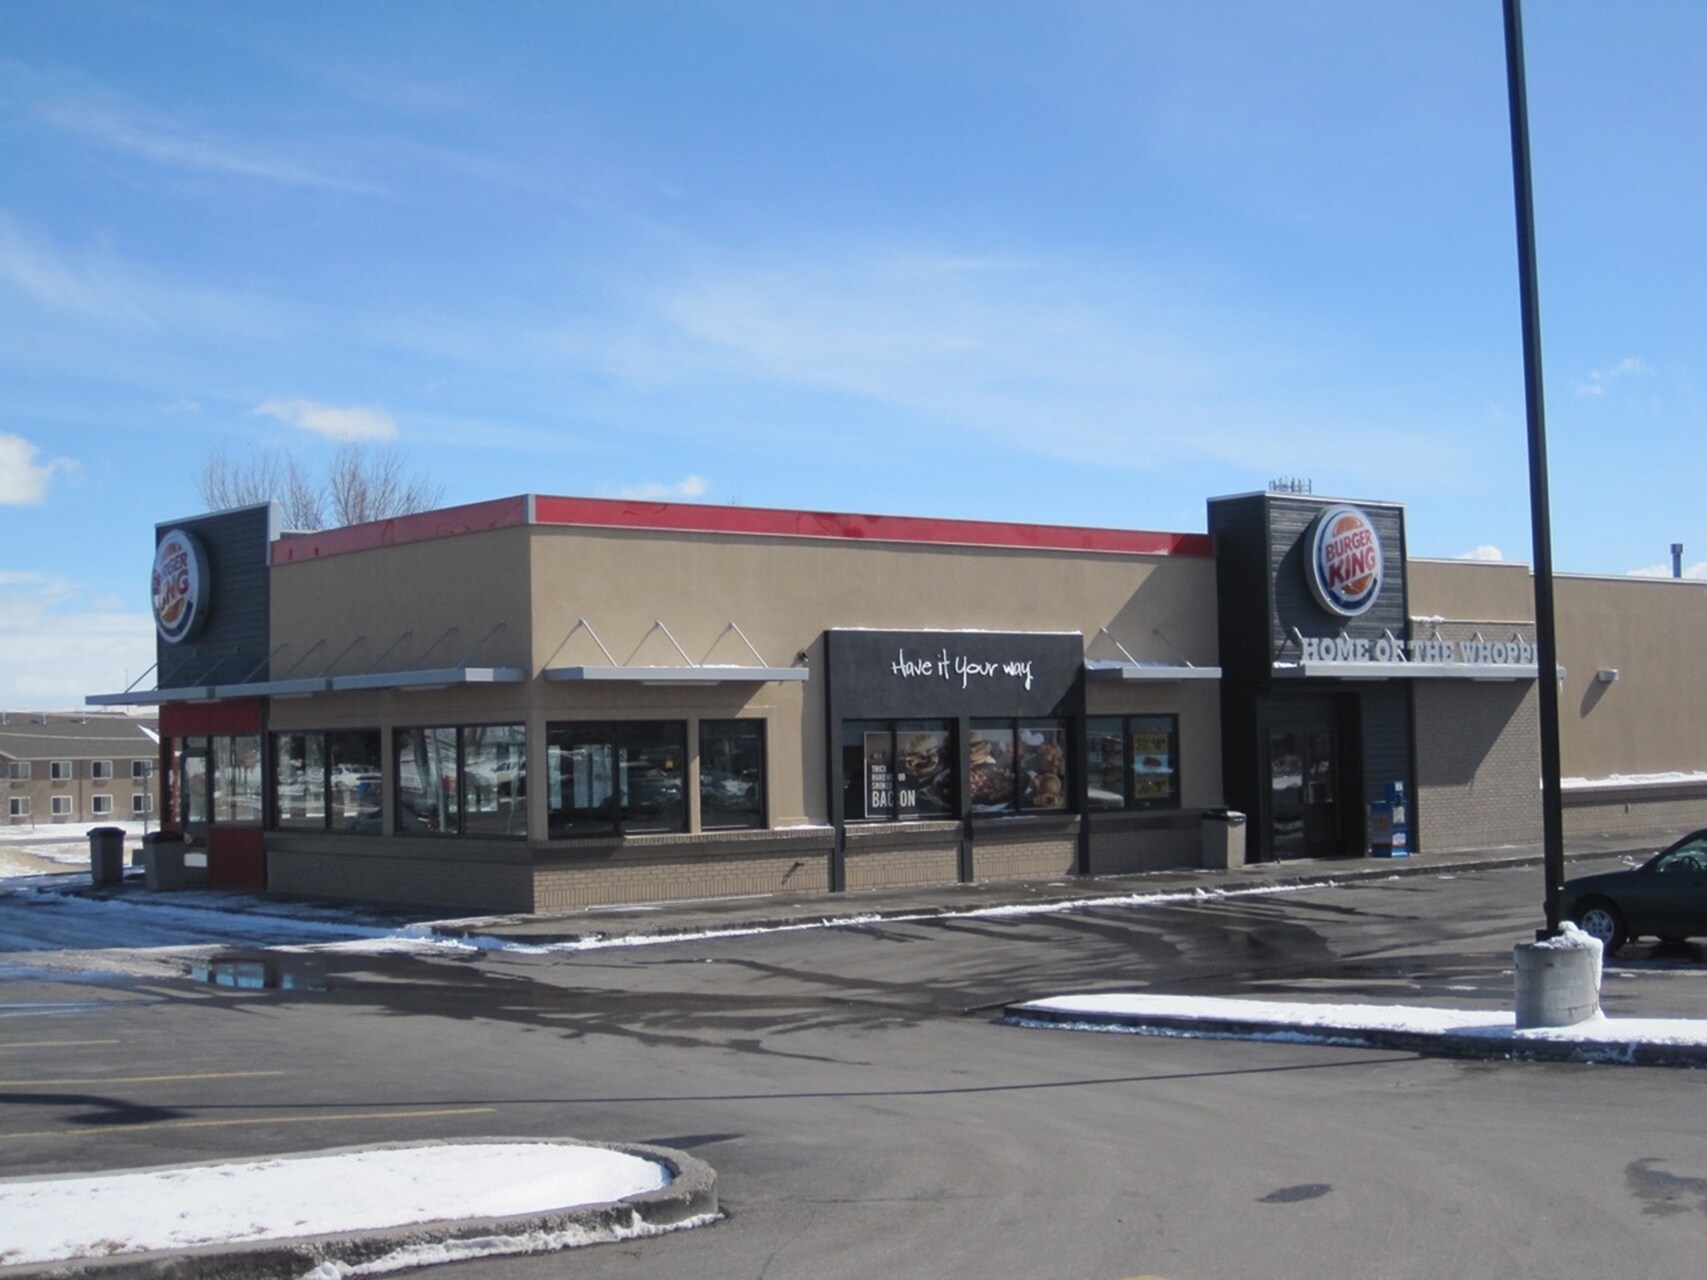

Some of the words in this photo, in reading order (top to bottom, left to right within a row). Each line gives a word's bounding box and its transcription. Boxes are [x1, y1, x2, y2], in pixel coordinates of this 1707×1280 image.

[1326, 530, 1373, 563] BURGER
[1328, 546, 1376, 589] KING
[891, 648, 933, 678] Have
[937, 648, 951, 680] it
[1302, 638, 1370, 663] HOME
[1375, 639, 1406, 663] OF
[1409, 640, 1453, 664] THE
[1460, 642, 1538, 665] WHOPP
[871, 789, 916, 808] BACON
